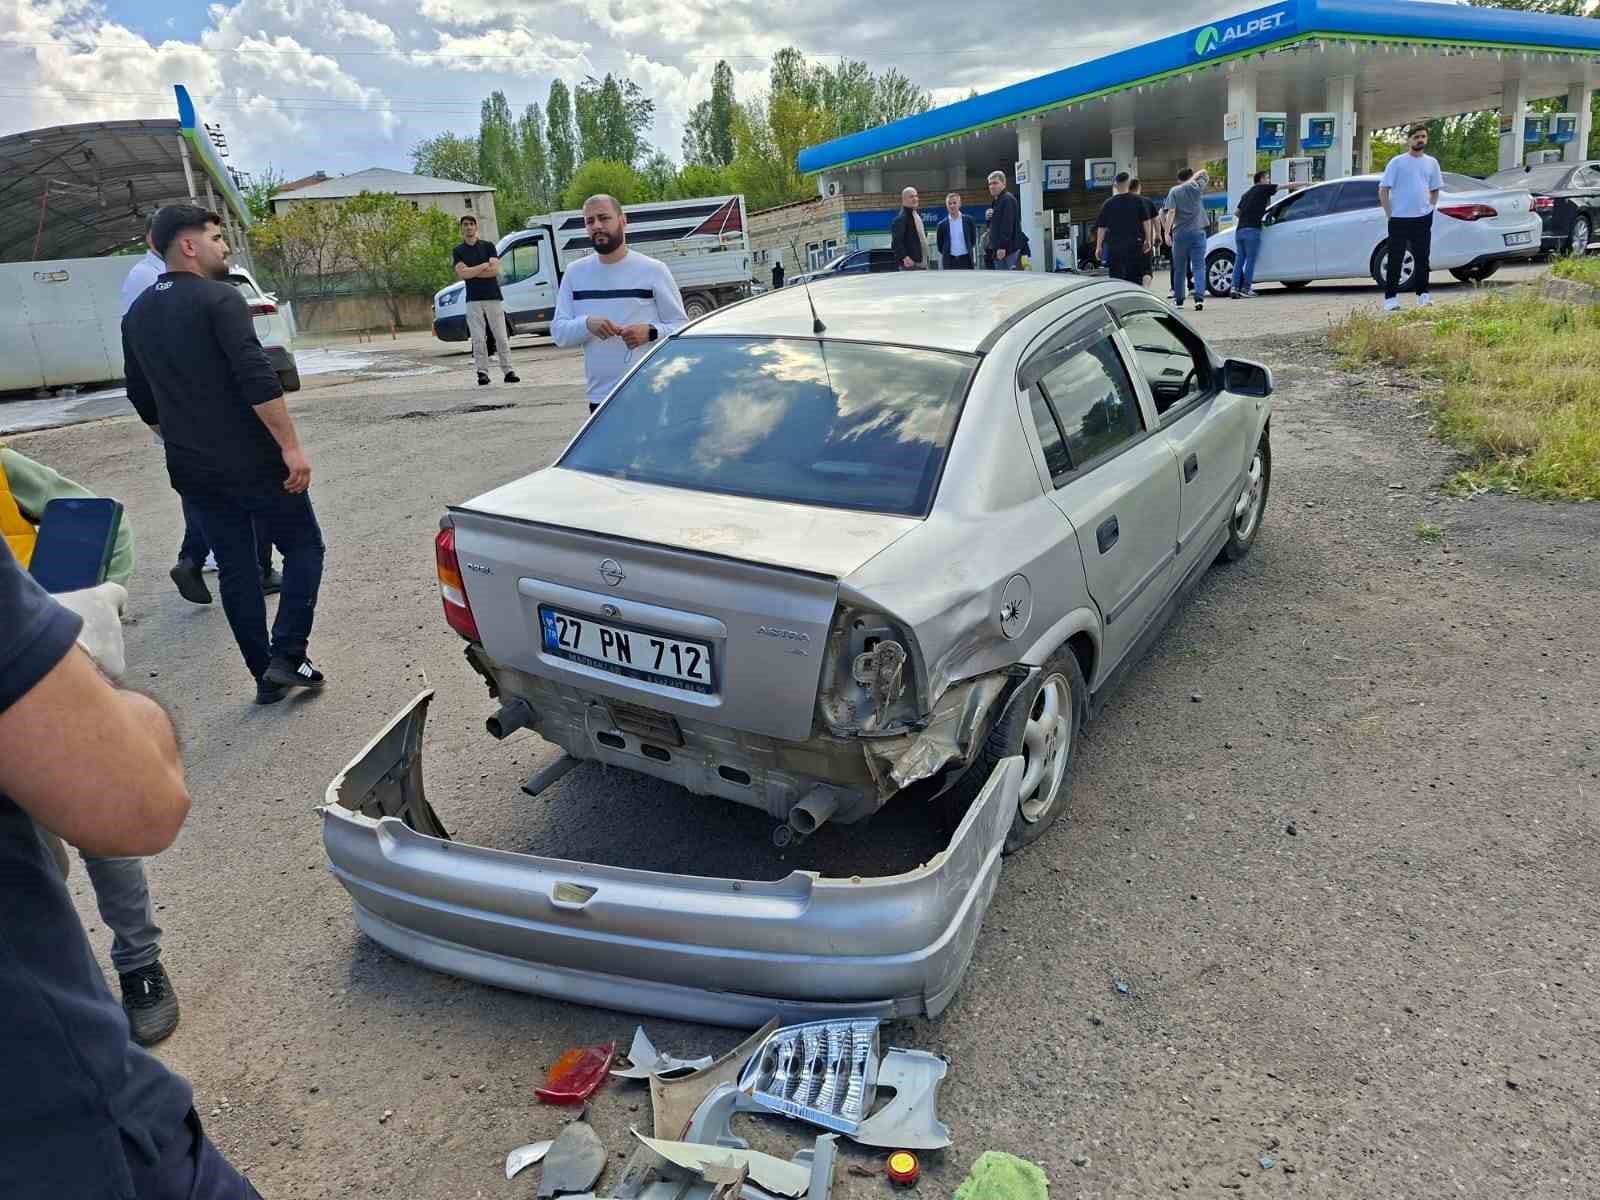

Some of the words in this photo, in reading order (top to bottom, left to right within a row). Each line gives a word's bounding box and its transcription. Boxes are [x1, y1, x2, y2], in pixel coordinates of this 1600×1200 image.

[1223, 11, 1285, 41] ALPET
[556, 616, 582, 649] 27
[600, 628, 632, 664] PN
[651, 639, 703, 679] 712
